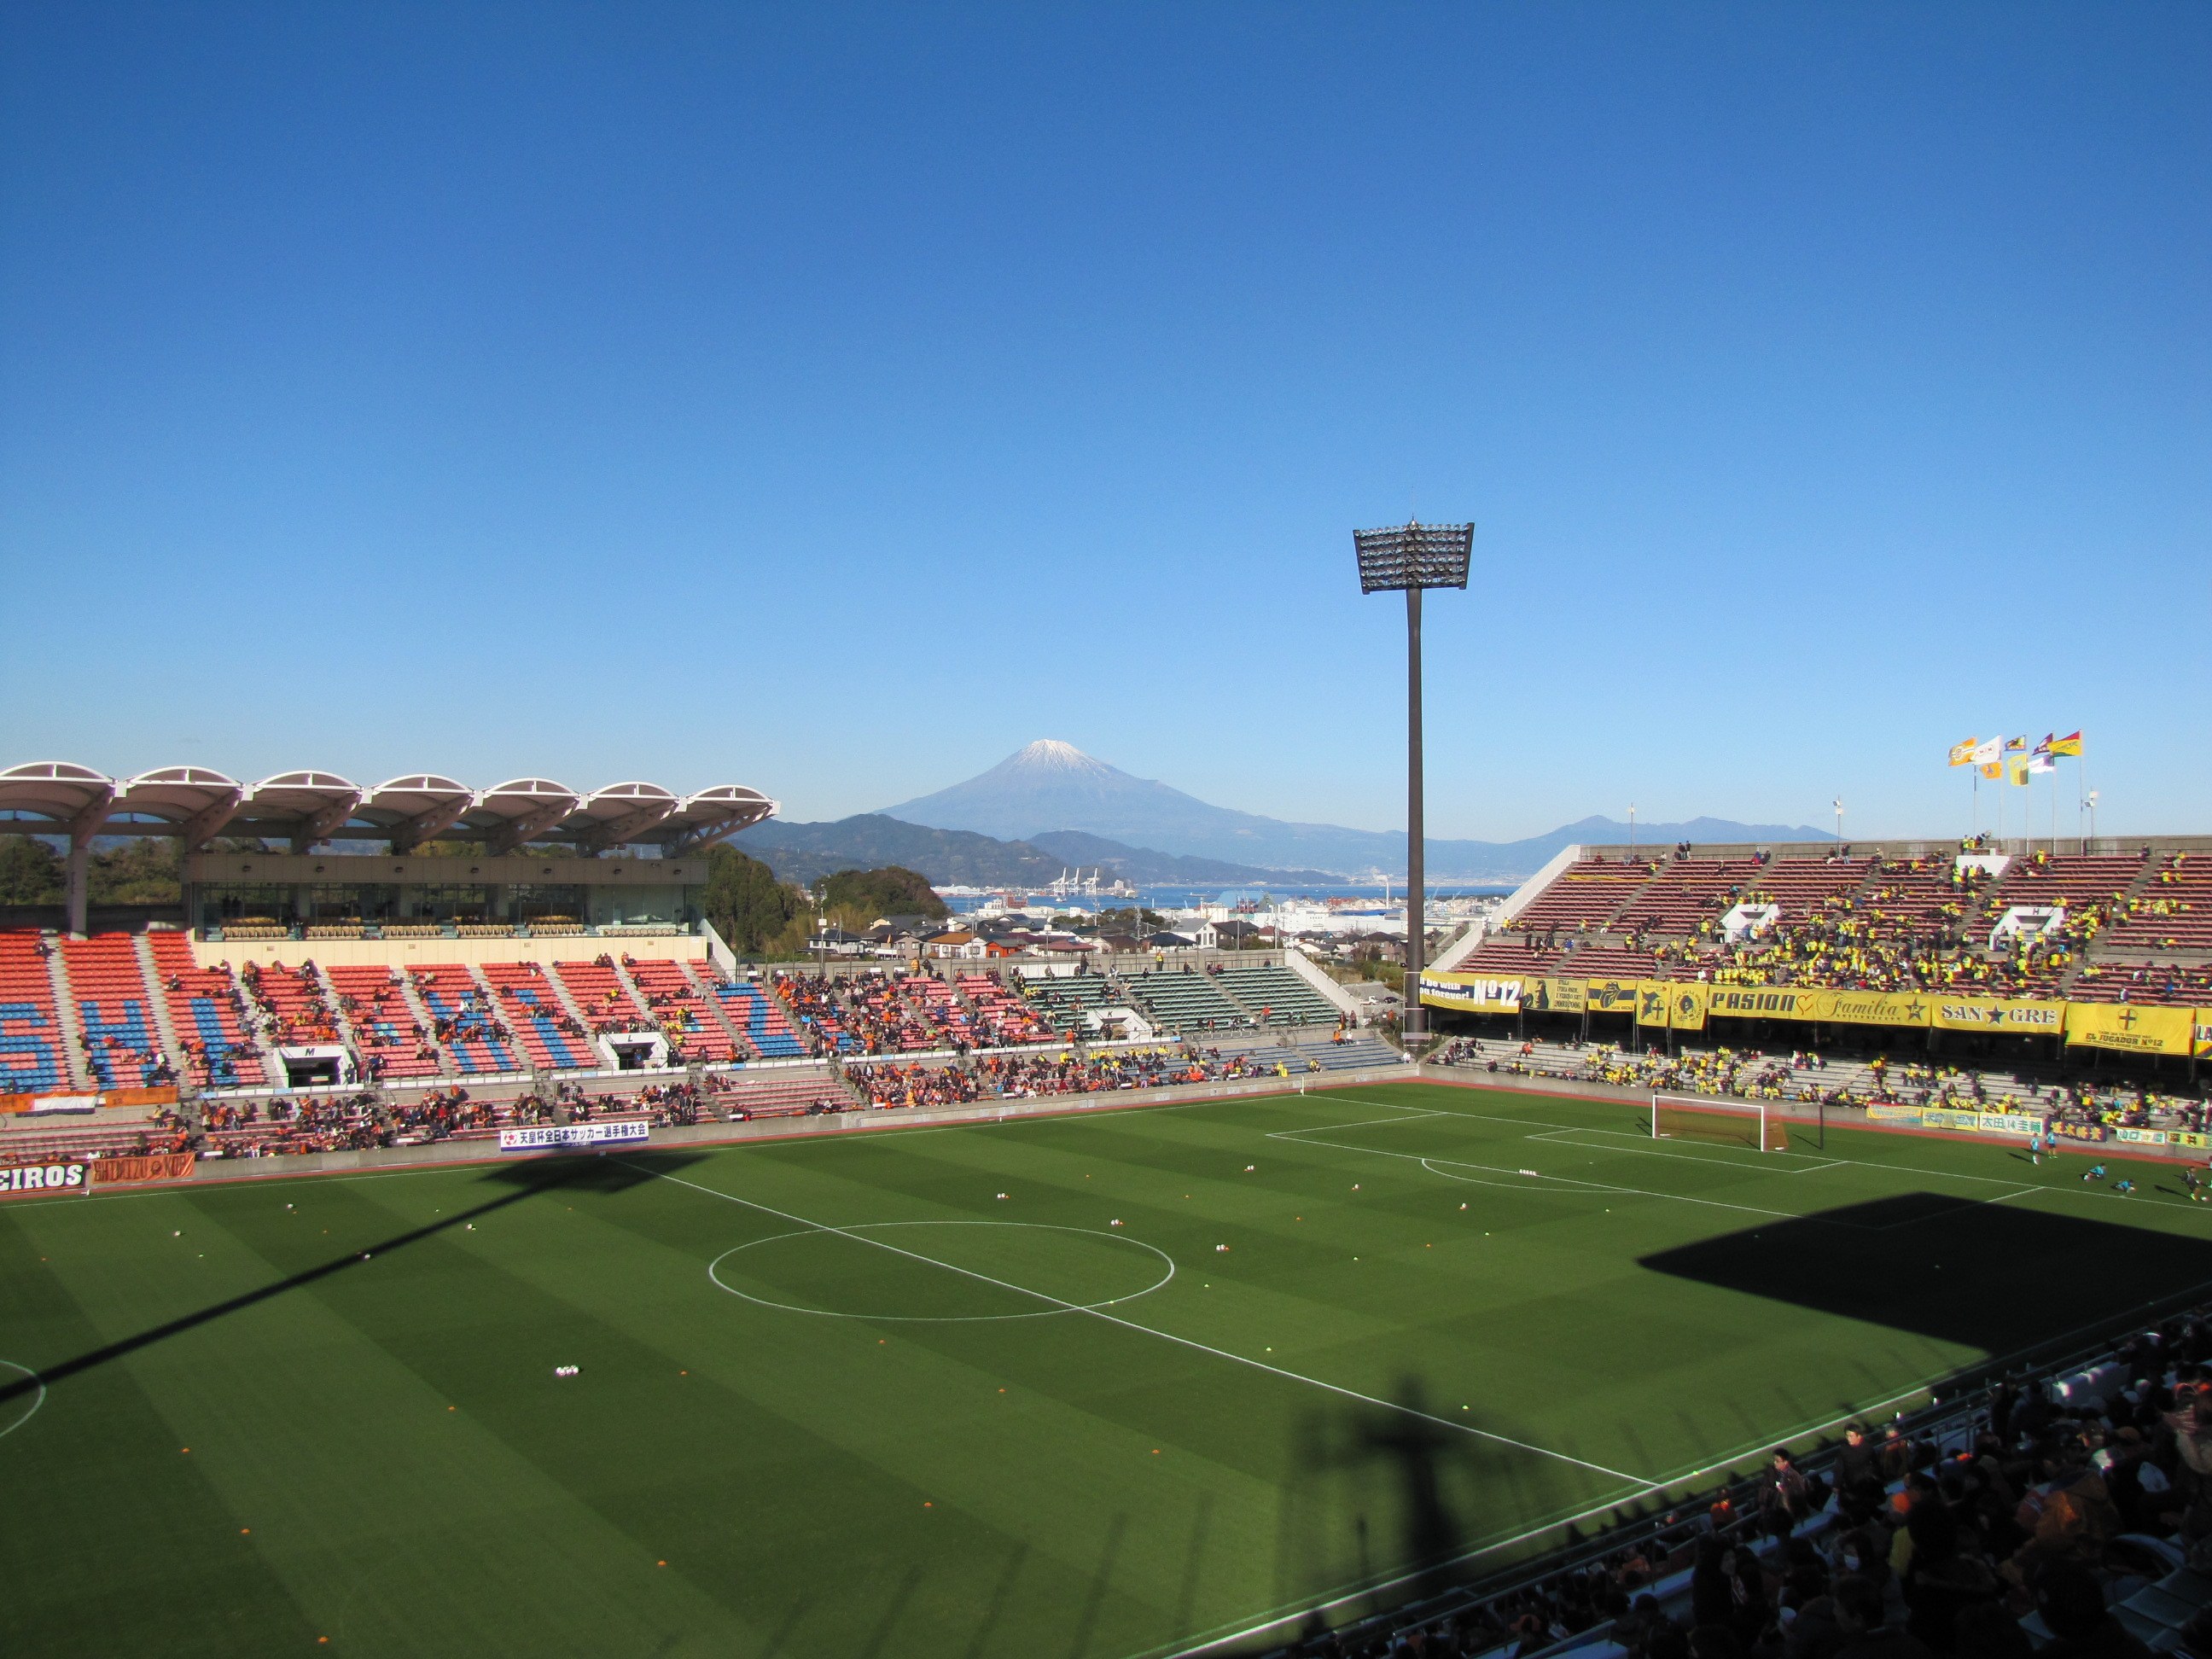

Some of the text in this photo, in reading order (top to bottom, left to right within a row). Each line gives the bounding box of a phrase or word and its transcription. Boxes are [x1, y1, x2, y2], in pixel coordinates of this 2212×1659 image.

[1440, 981, 1461, 991] with
[1816, 992, 1898, 1016] Familia
[2099, 1034, 2139, 1045] JUGADOR
[305, 1047, 316, 1057] M
[520, 1122, 646, 1144] 天皇杯全日本サッカー選手権大会
